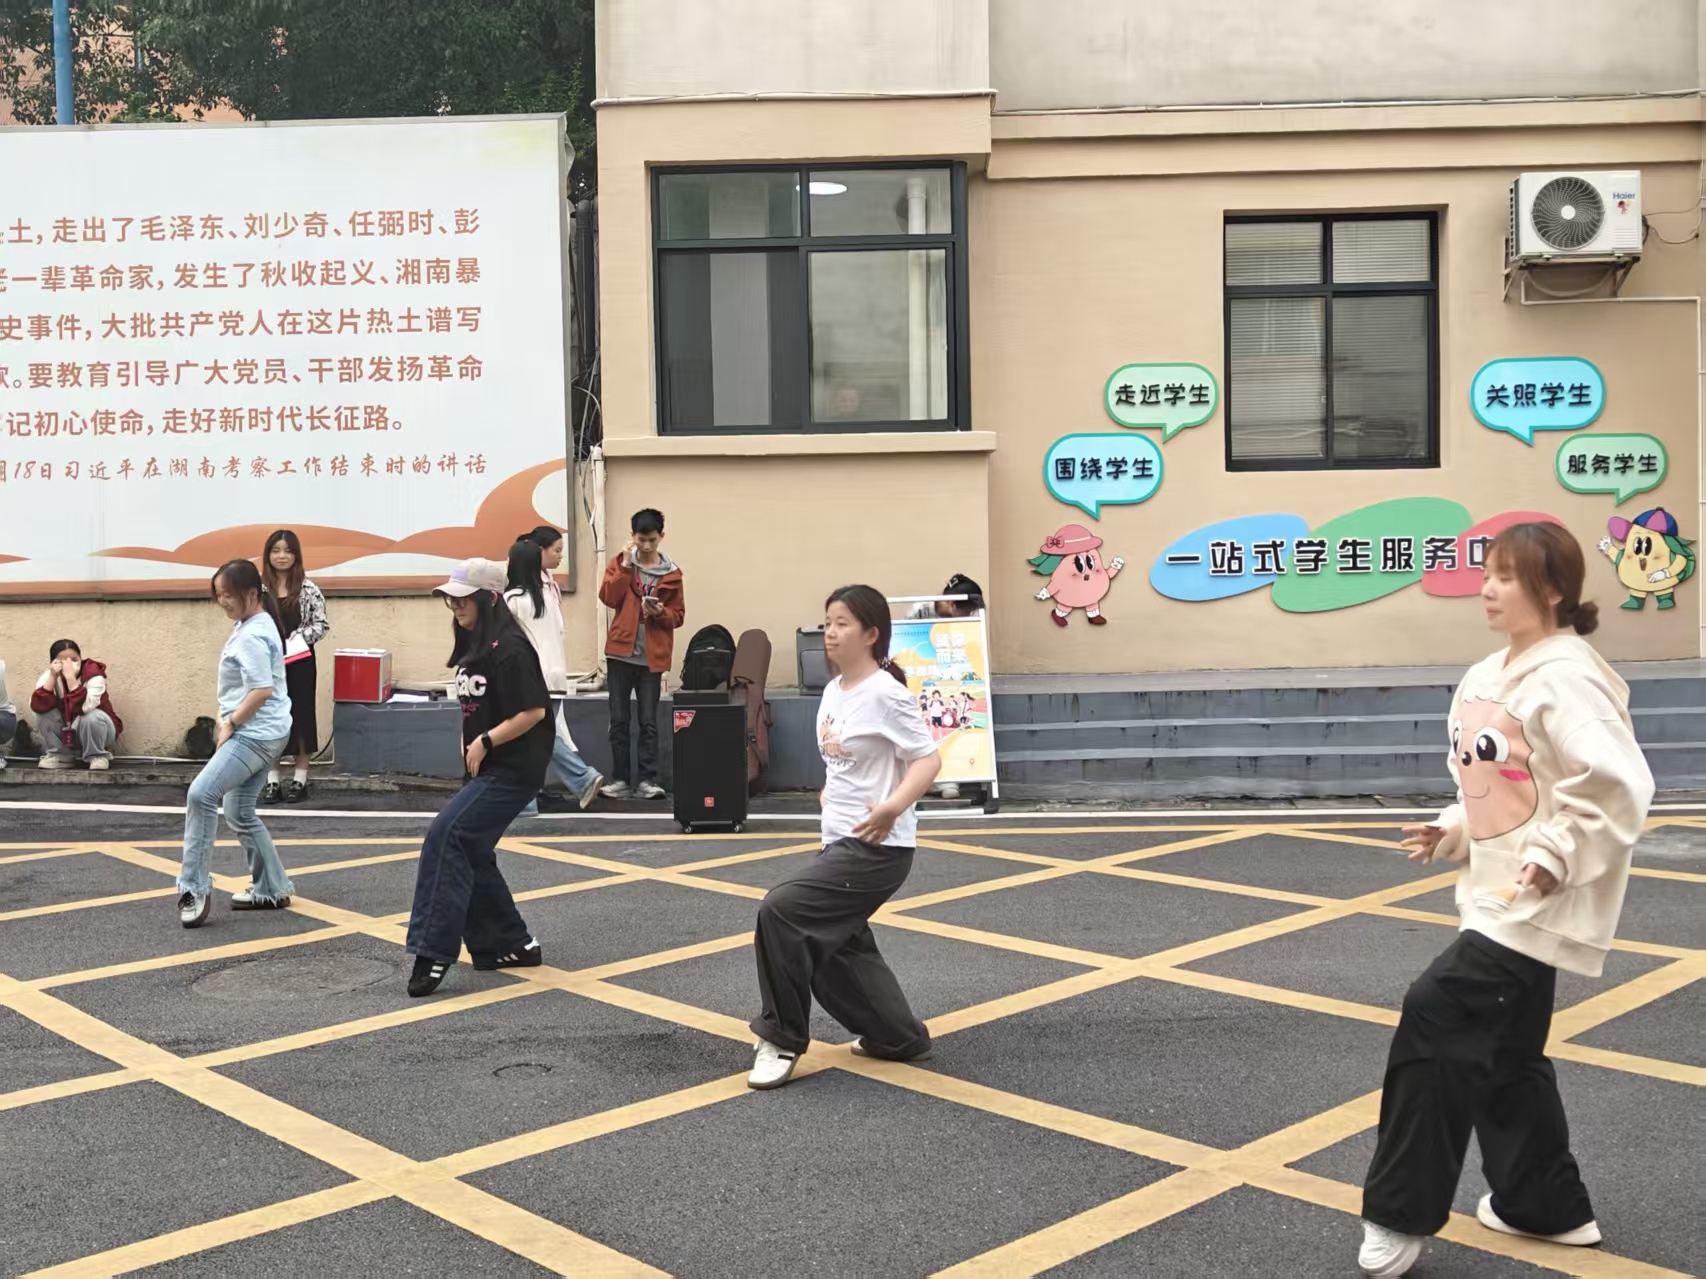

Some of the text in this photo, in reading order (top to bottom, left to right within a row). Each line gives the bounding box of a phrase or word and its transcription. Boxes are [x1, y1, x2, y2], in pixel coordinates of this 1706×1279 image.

[1612, 192, 1636, 200] Haier
[0, 208, 480, 245] 土，走出了毛泽东、刘少奇、任弼时、彭
[1115, 383, 1210, 406] 走近学生
[1486, 382, 1593, 408] 关照学生
[0, 404, 402, 438] 记初心使命，走好新时代长征路。
[1055, 457, 1154, 480] 围绕学生
[1567, 453, 1658, 475] 服务学生
